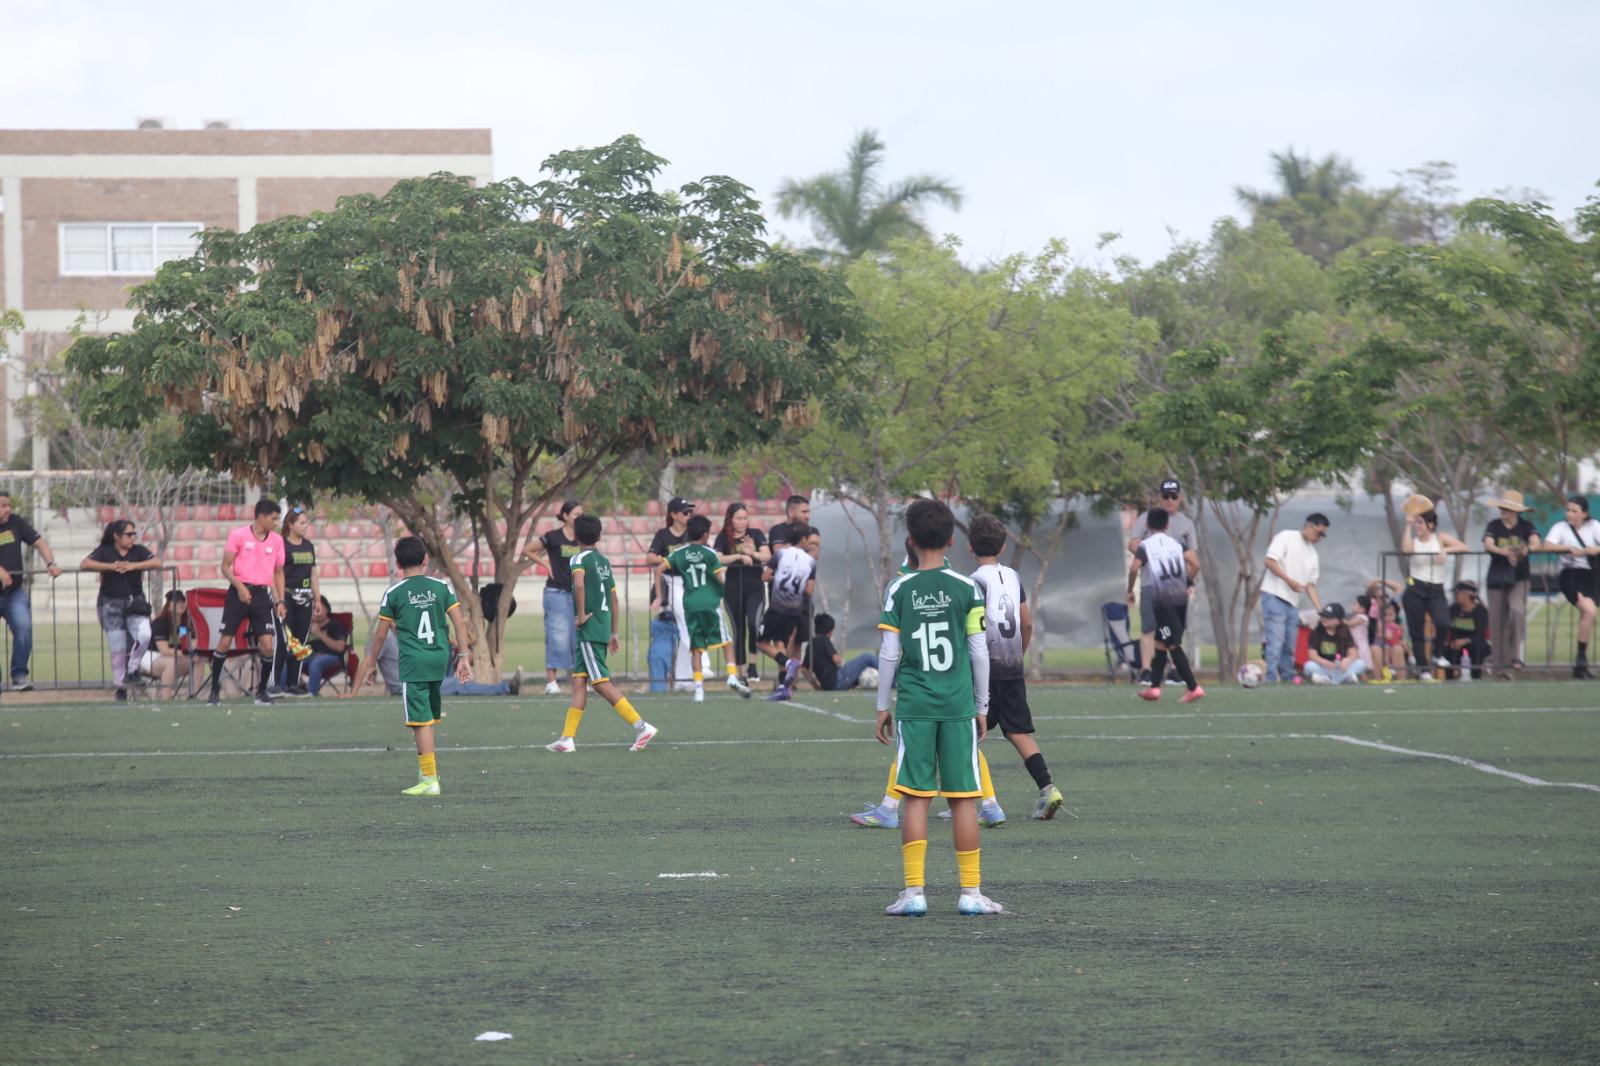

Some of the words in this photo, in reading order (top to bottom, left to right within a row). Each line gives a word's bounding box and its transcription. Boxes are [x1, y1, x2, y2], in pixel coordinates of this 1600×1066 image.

[686, 563, 707, 588] 17
[1153, 553, 1182, 580] 10
[778, 568, 801, 595] 24
[600, 581, 609, 612] 2
[417, 610, 435, 645] 4
[998, 594, 1016, 639] 3
[911, 621, 954, 672] 15
[1159, 625, 1171, 640] 10
